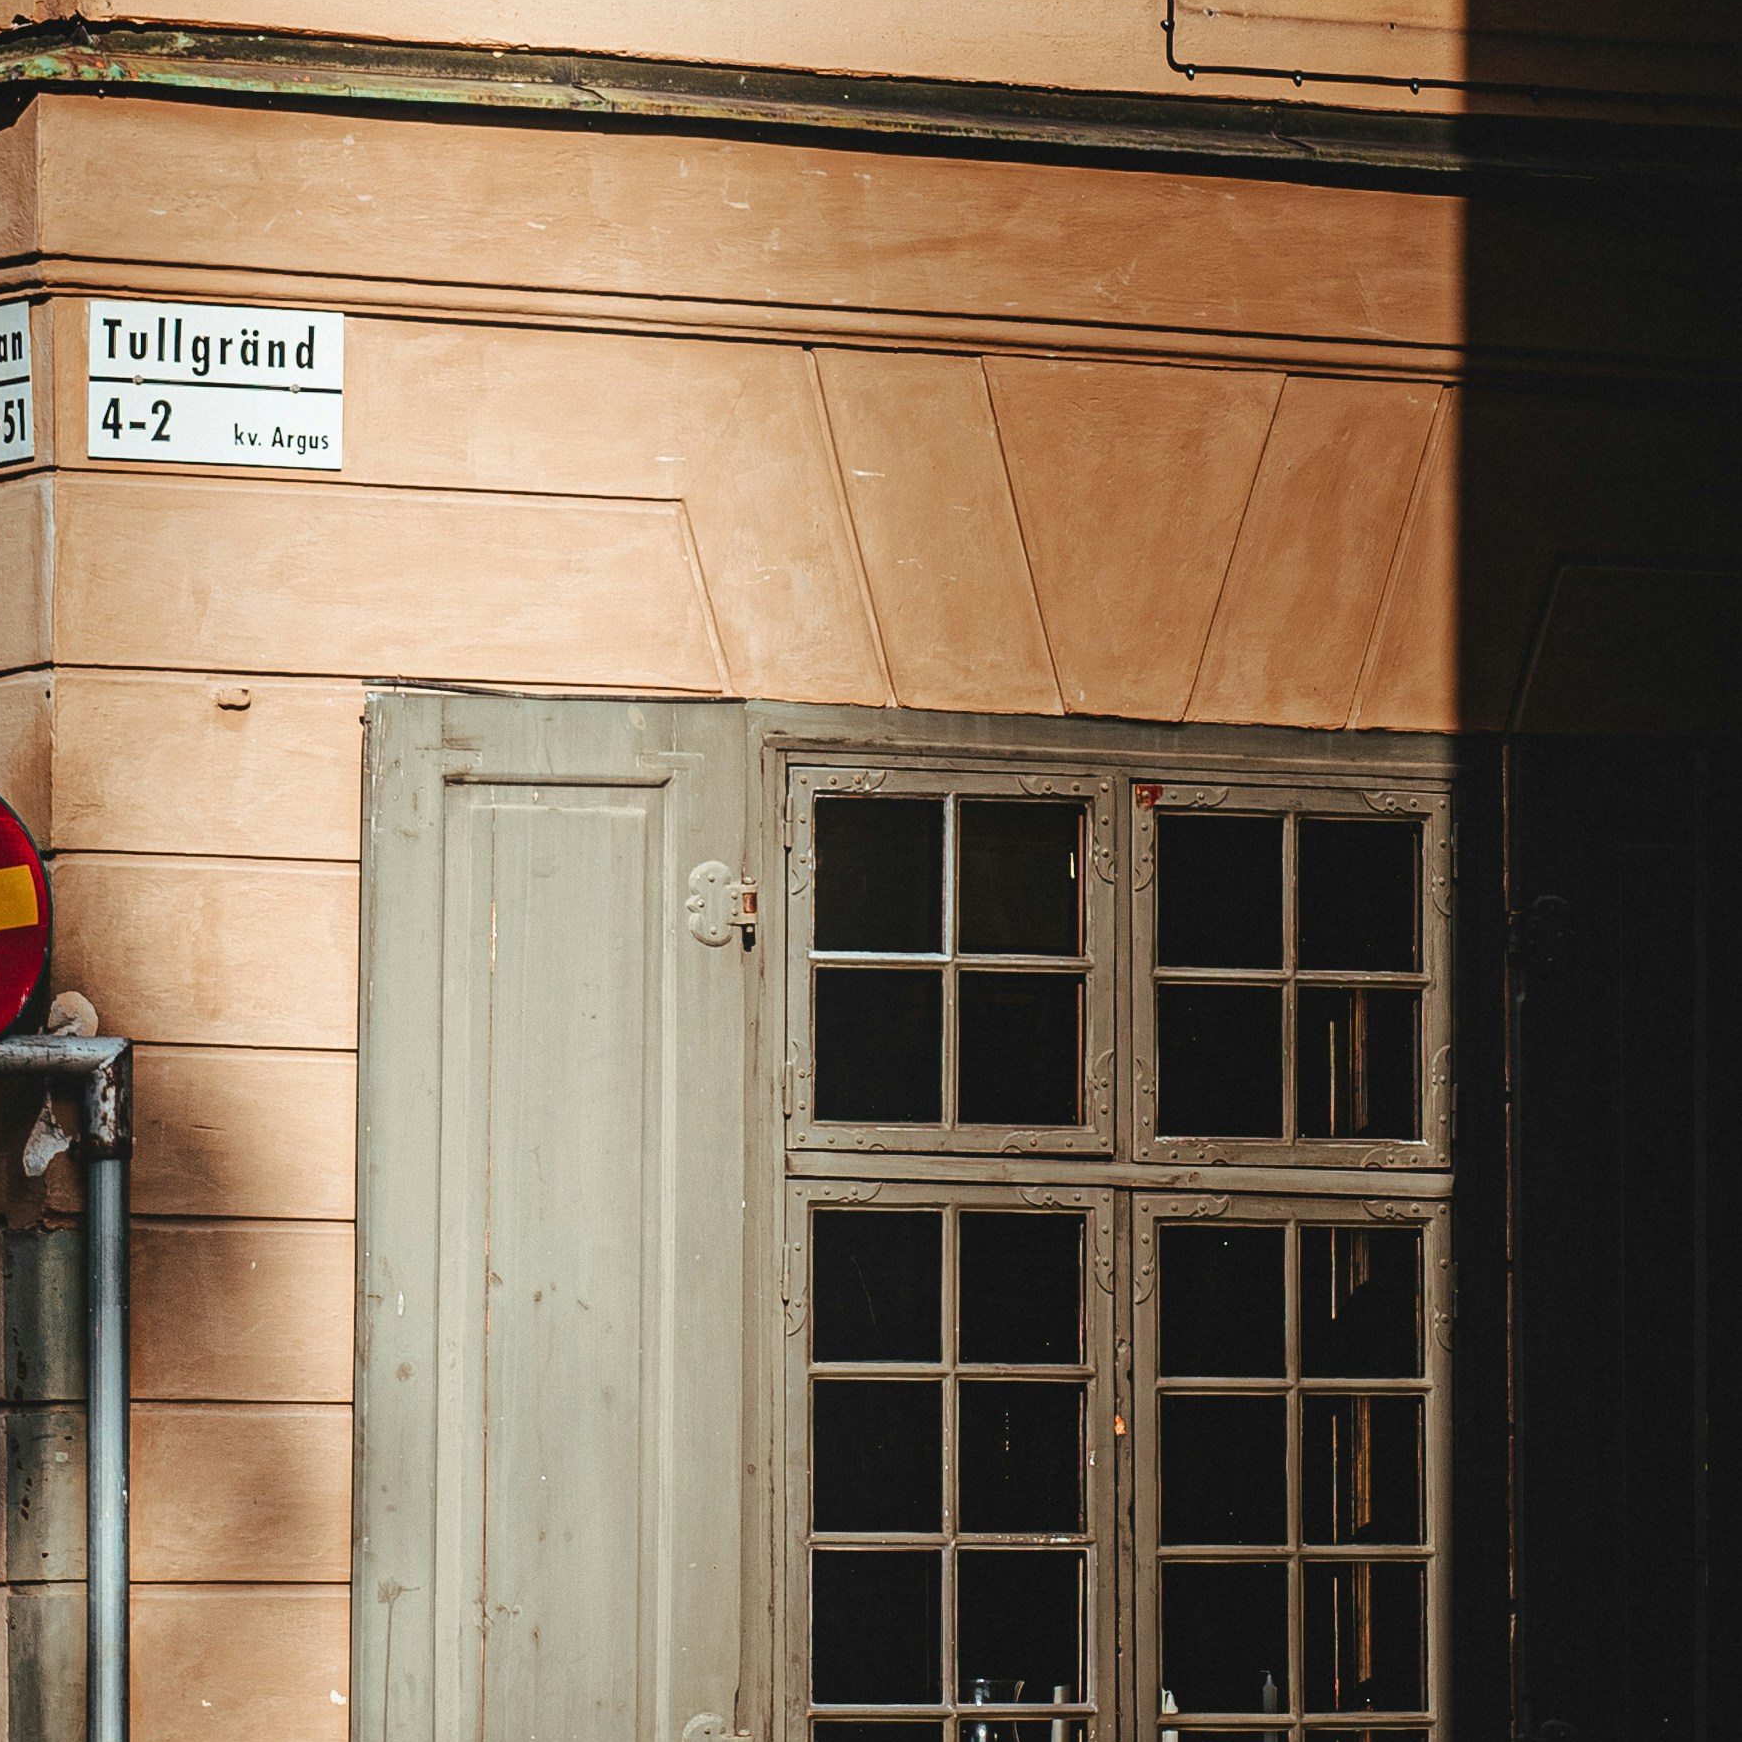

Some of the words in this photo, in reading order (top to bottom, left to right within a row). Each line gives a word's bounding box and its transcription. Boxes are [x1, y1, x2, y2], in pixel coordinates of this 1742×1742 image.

[102, 317, 316, 377] Tullgränd
[102, 397, 173, 442] 4-2
[234, 422, 264, 447] kv.
[271, 426, 330, 455] Argus
